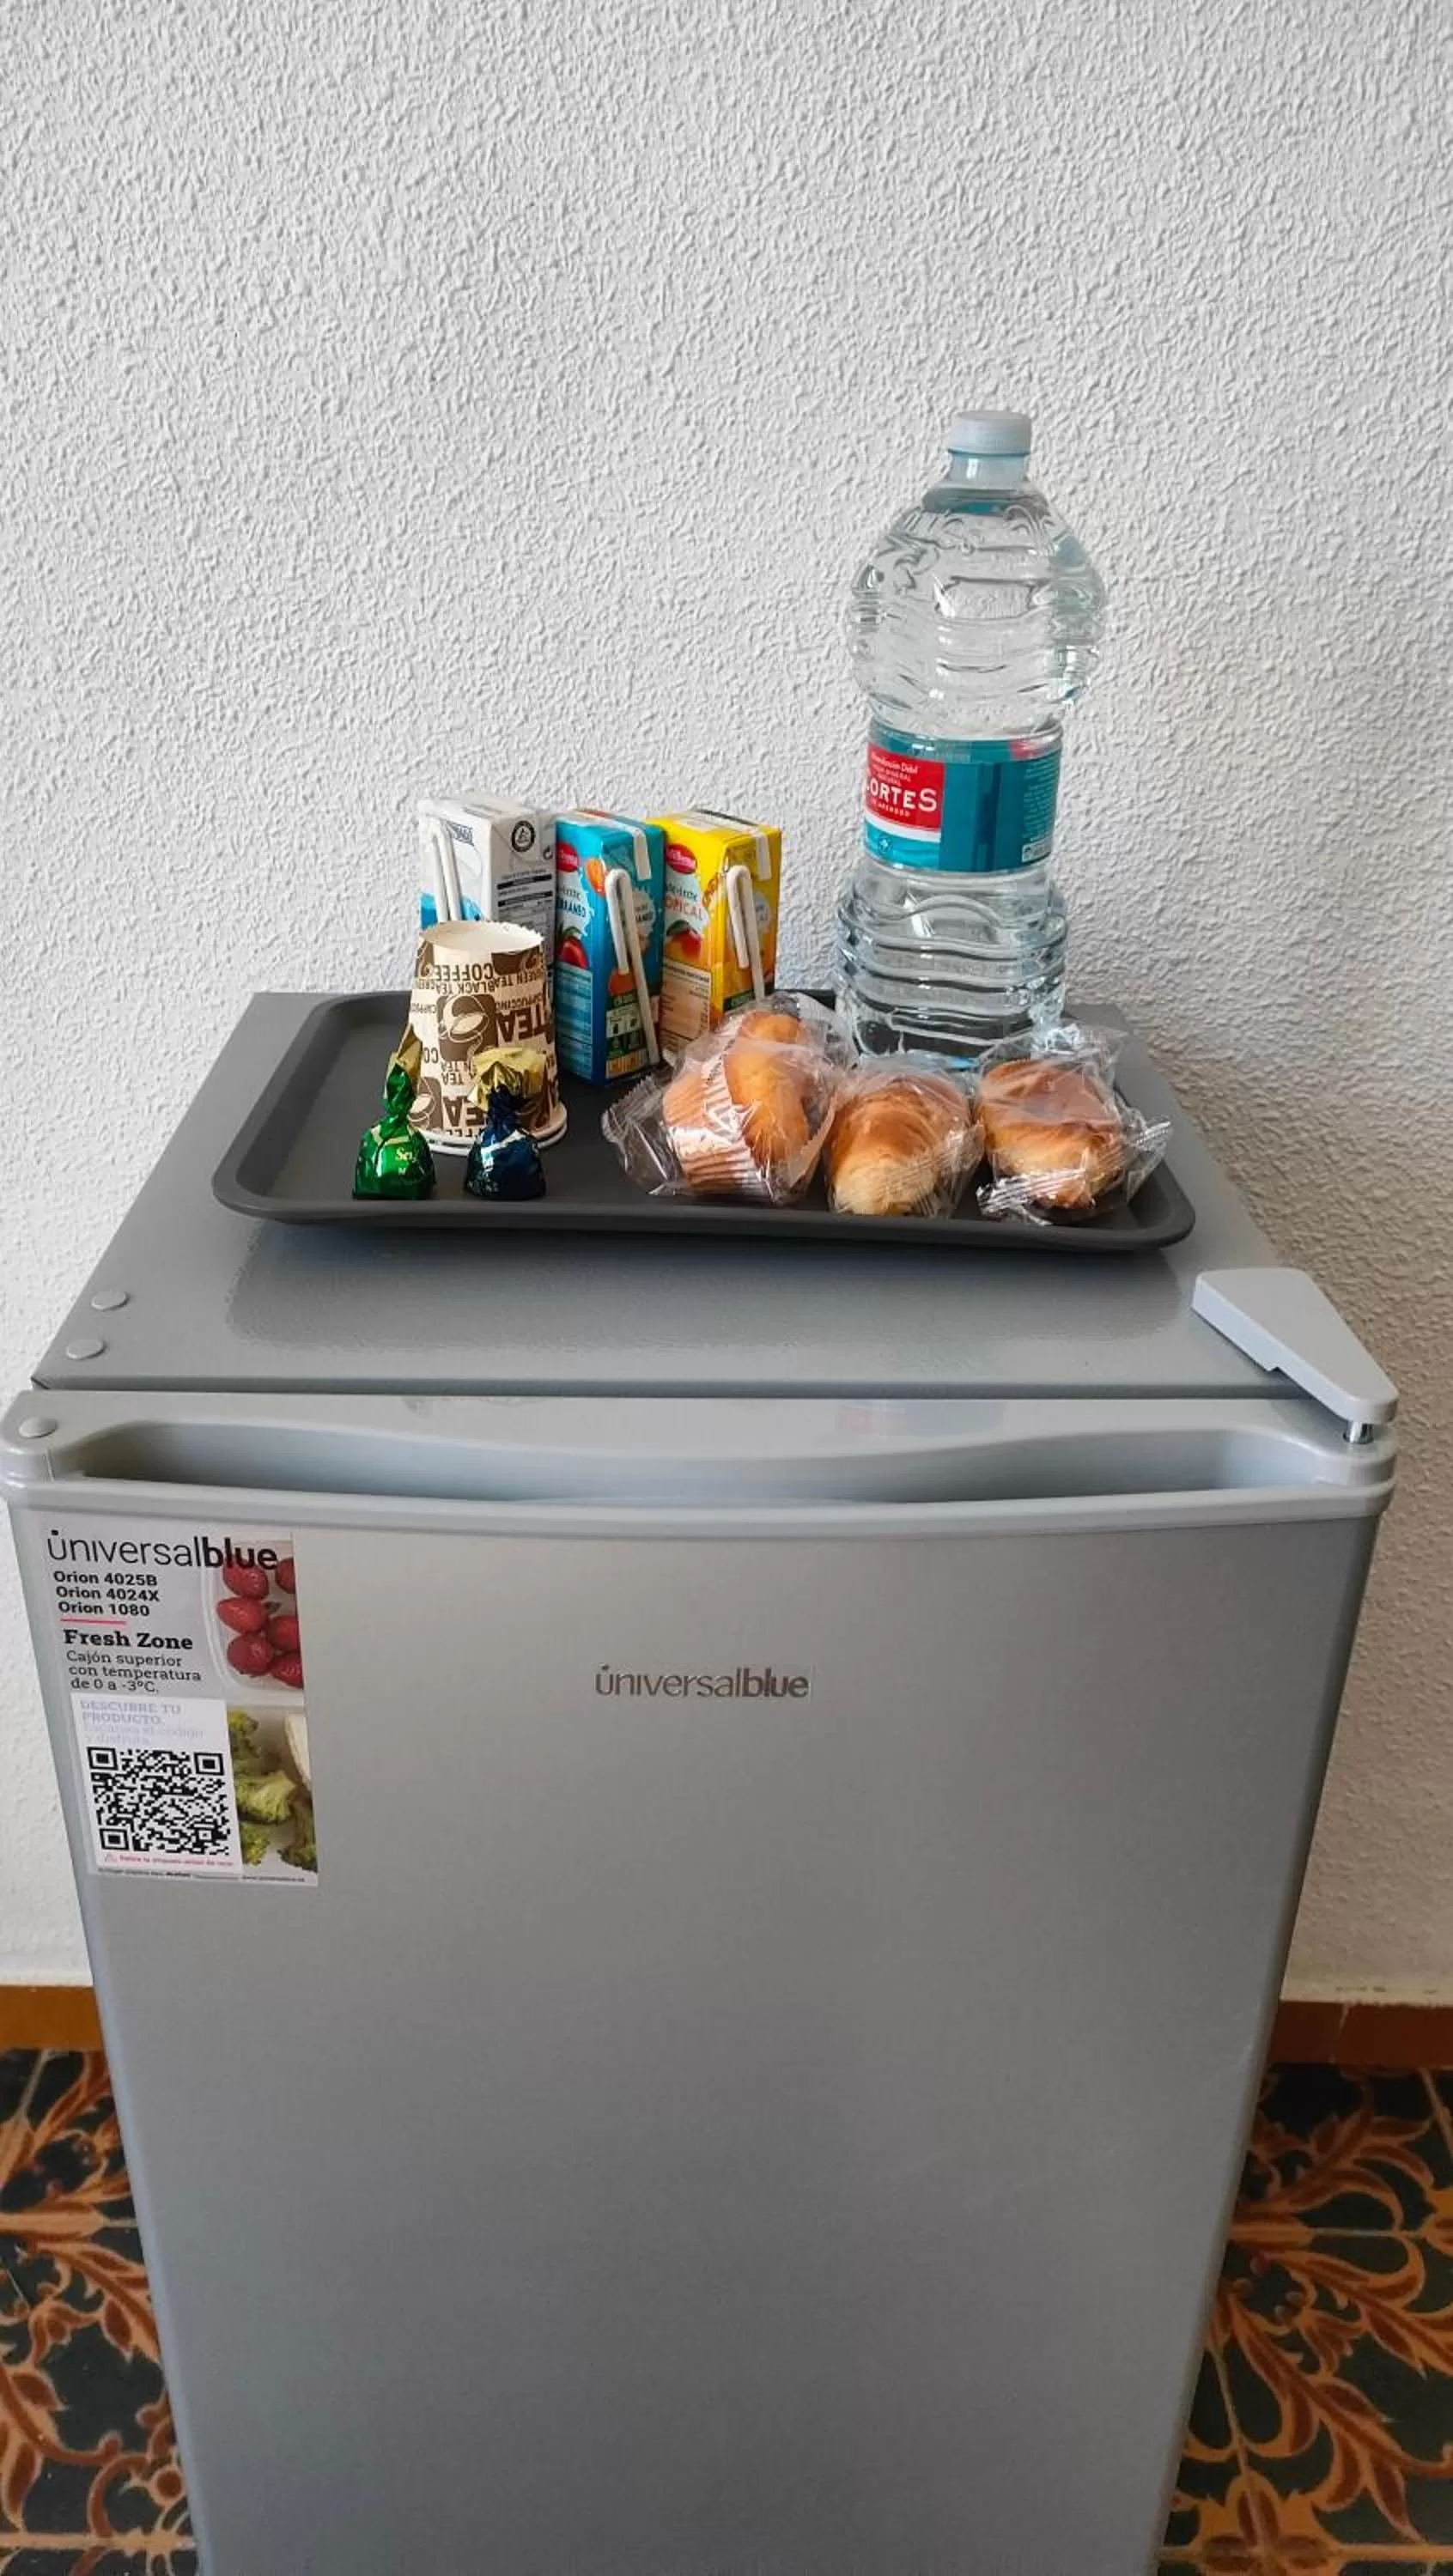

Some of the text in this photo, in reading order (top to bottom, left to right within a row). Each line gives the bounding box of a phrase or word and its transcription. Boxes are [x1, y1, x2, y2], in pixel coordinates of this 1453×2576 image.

[866, 777, 938, 812] ORTES
[434, 963, 494, 981] COFFEE
[436, 980, 495, 994] BLACK TEA
[495, 1004, 547, 1042] TEA
[442, 1072, 465, 1086] TEA
[442, 1095, 488, 1127] EA
[53, 1571, 157, 1587] Orion 4025B
[56, 1585, 161, 1602] Orion 4024X
[58, 1601, 150, 1617] Orion 1080
[63, 1629, 194, 1650] Fresh Zone
[66, 1649, 183, 1668] Cajón superior
[69, 1666, 202, 1681] con temperatura
[70, 1677, 90, 1689] de
[94, 1679, 104, 1690] 0
[107, 1680, 118, 1691] a
